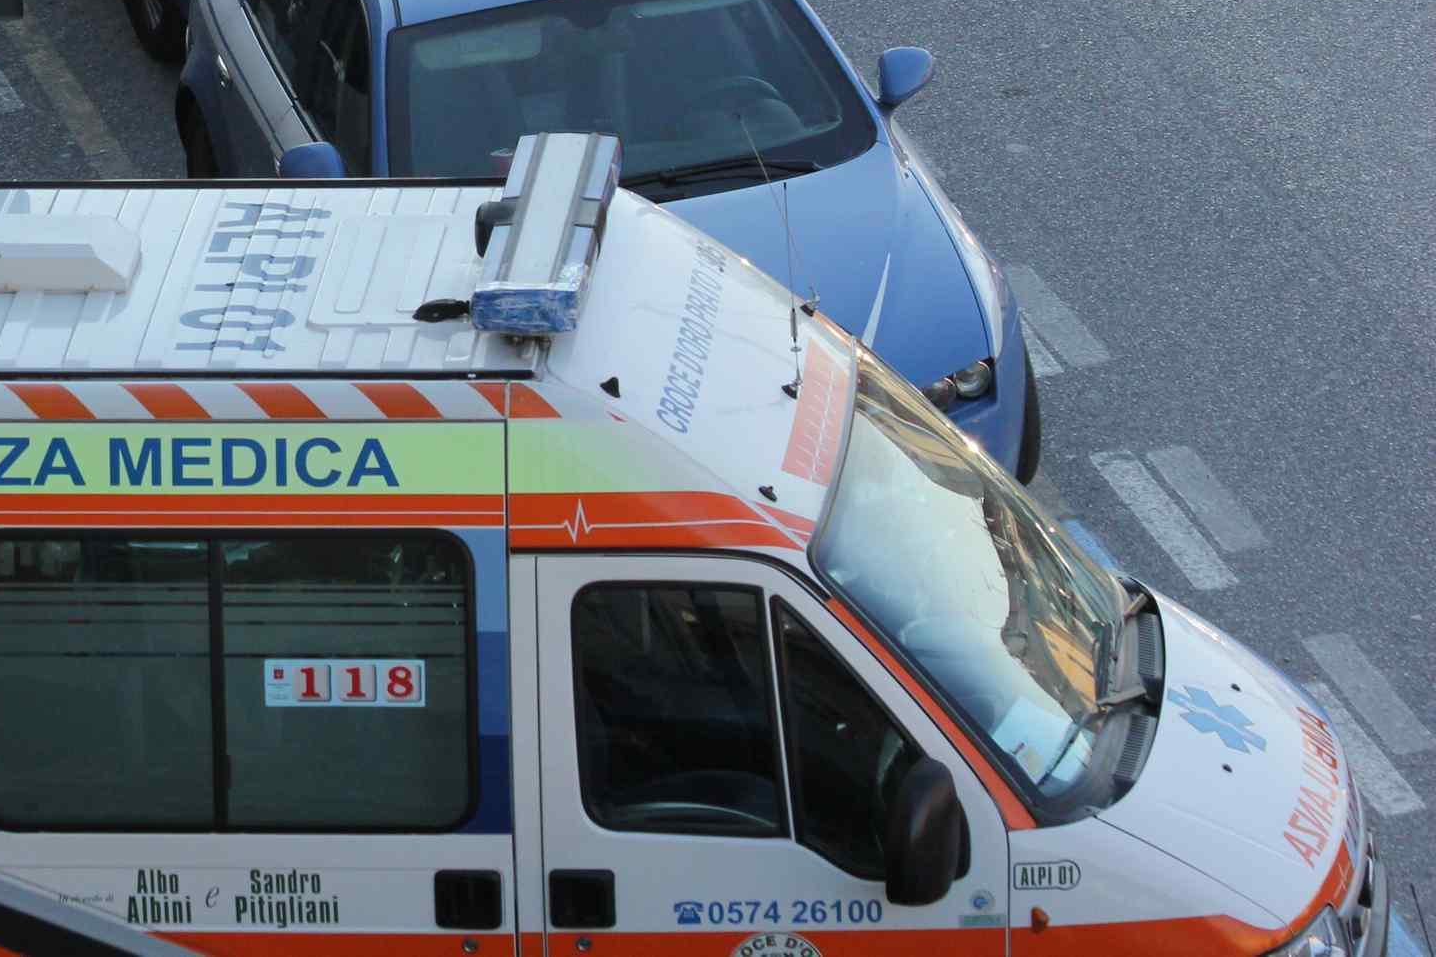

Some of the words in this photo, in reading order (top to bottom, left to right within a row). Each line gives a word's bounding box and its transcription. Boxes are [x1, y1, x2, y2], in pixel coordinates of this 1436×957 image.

[194, 202, 332, 292] ALPI
[656, 363, 701, 434] CROCE
[109, 437, 400, 487] MEDICA
[136, 869, 180, 894] Albo
[250, 868, 322, 894] Sandro
[1020, 866, 1053, 886] ALPI
[1059, 865, 1074, 884] 01
[127, 895, 192, 923] Albini
[204, 886, 220, 909] e
[708, 899, 782, 924] 0574
[792, 898, 883, 924] 26100
[235, 895, 340, 928] Pitigliani
